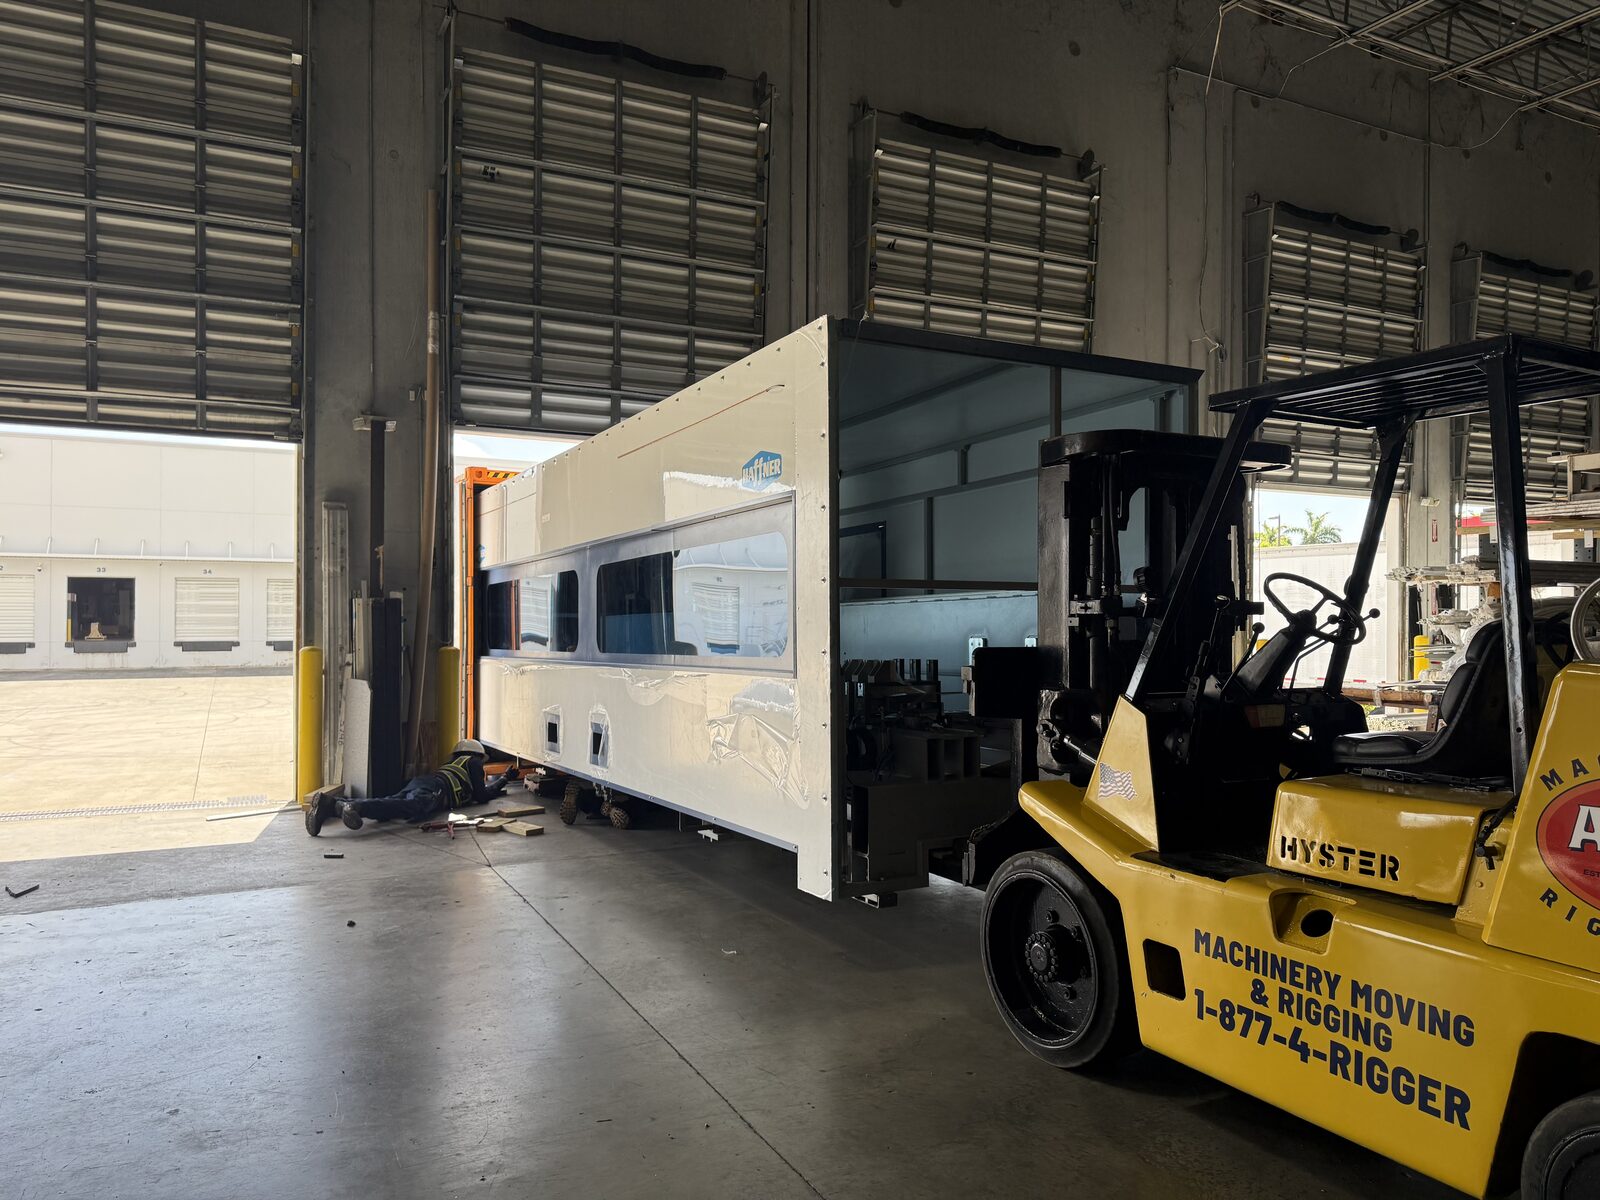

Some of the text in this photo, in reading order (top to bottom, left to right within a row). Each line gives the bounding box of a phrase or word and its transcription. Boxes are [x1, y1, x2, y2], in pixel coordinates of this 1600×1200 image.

[1540, 755, 1600, 791] MA
[1281, 836, 1400, 881] HYSTER
[1195, 928, 1475, 1047] MACHINERY MOVING
[1250, 979, 1393, 1052] & RIGGING
[1194, 988, 1471, 1131] 1-877-4-RIGGER
